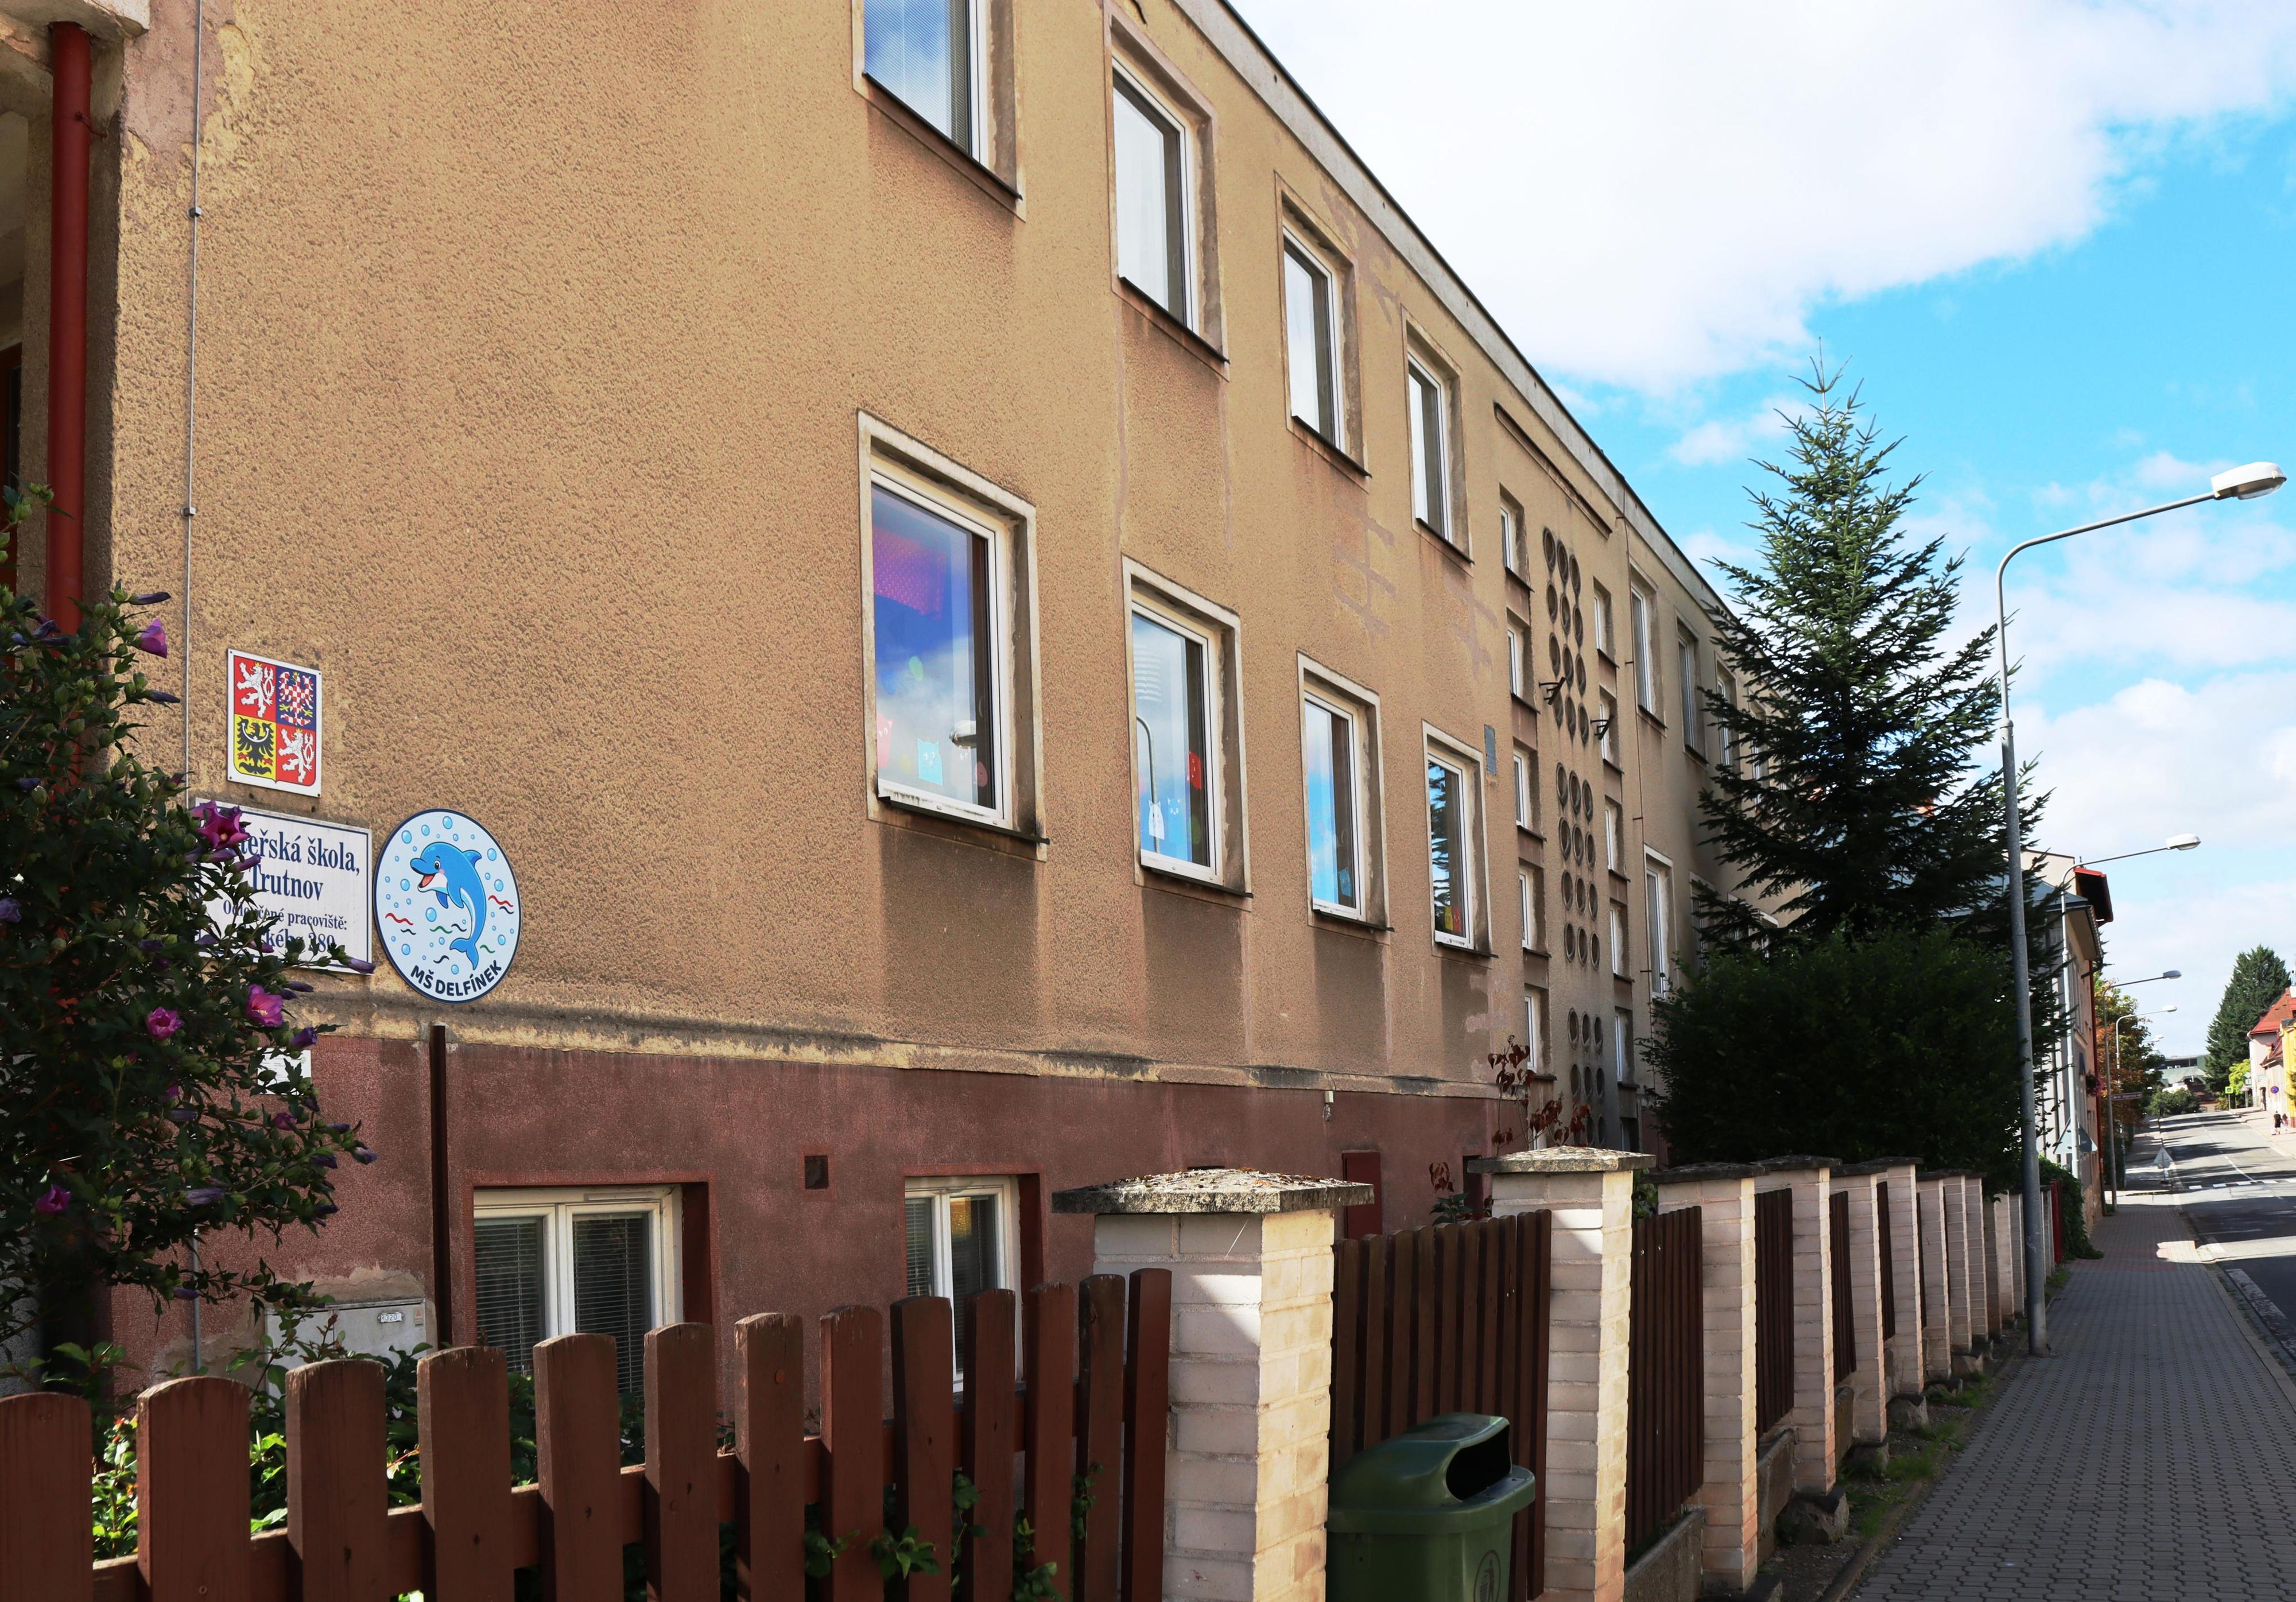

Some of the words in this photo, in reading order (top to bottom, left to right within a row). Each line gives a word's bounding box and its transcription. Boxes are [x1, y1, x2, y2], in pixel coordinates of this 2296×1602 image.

[240, 828, 301, 863] teřská
[308, 836, 360, 876] škola,
[249, 863, 323, 901] Trutnov
[288, 913, 347, 930] pracoviště:
[410, 965, 434, 989] MŠ
[435, 960, 502, 996] DELFÍNEK
